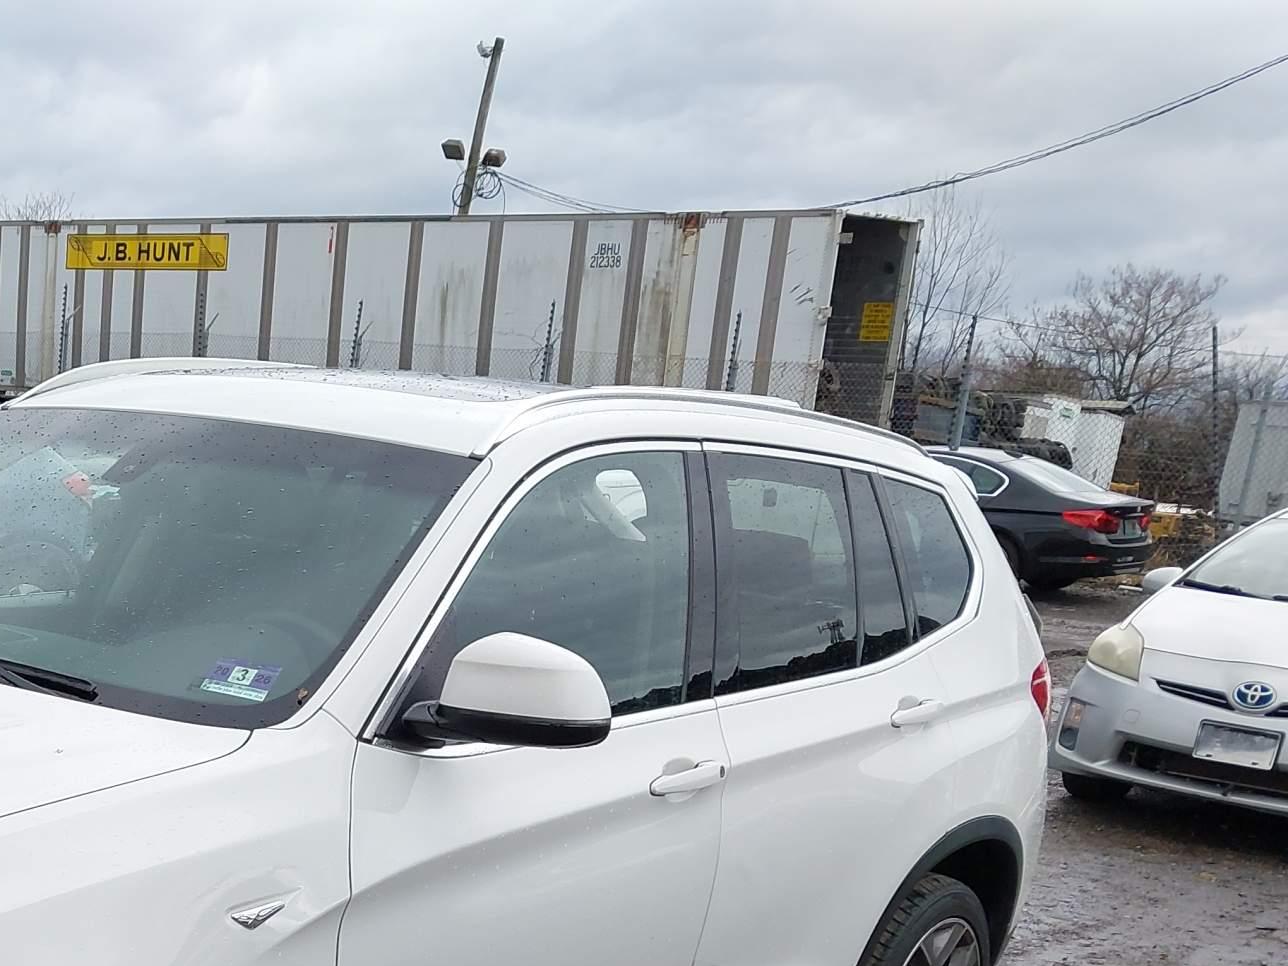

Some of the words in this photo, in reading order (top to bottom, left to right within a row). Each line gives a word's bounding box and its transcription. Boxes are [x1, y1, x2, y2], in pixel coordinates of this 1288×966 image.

[97, 242, 131, 262] J.B.
[137, 242, 195, 262] HUNT
[594, 243, 621, 256] JBHU
[590, 255, 622, 268] 212338
[214, 664, 230, 676] 20
[236, 669, 249, 682] 3
